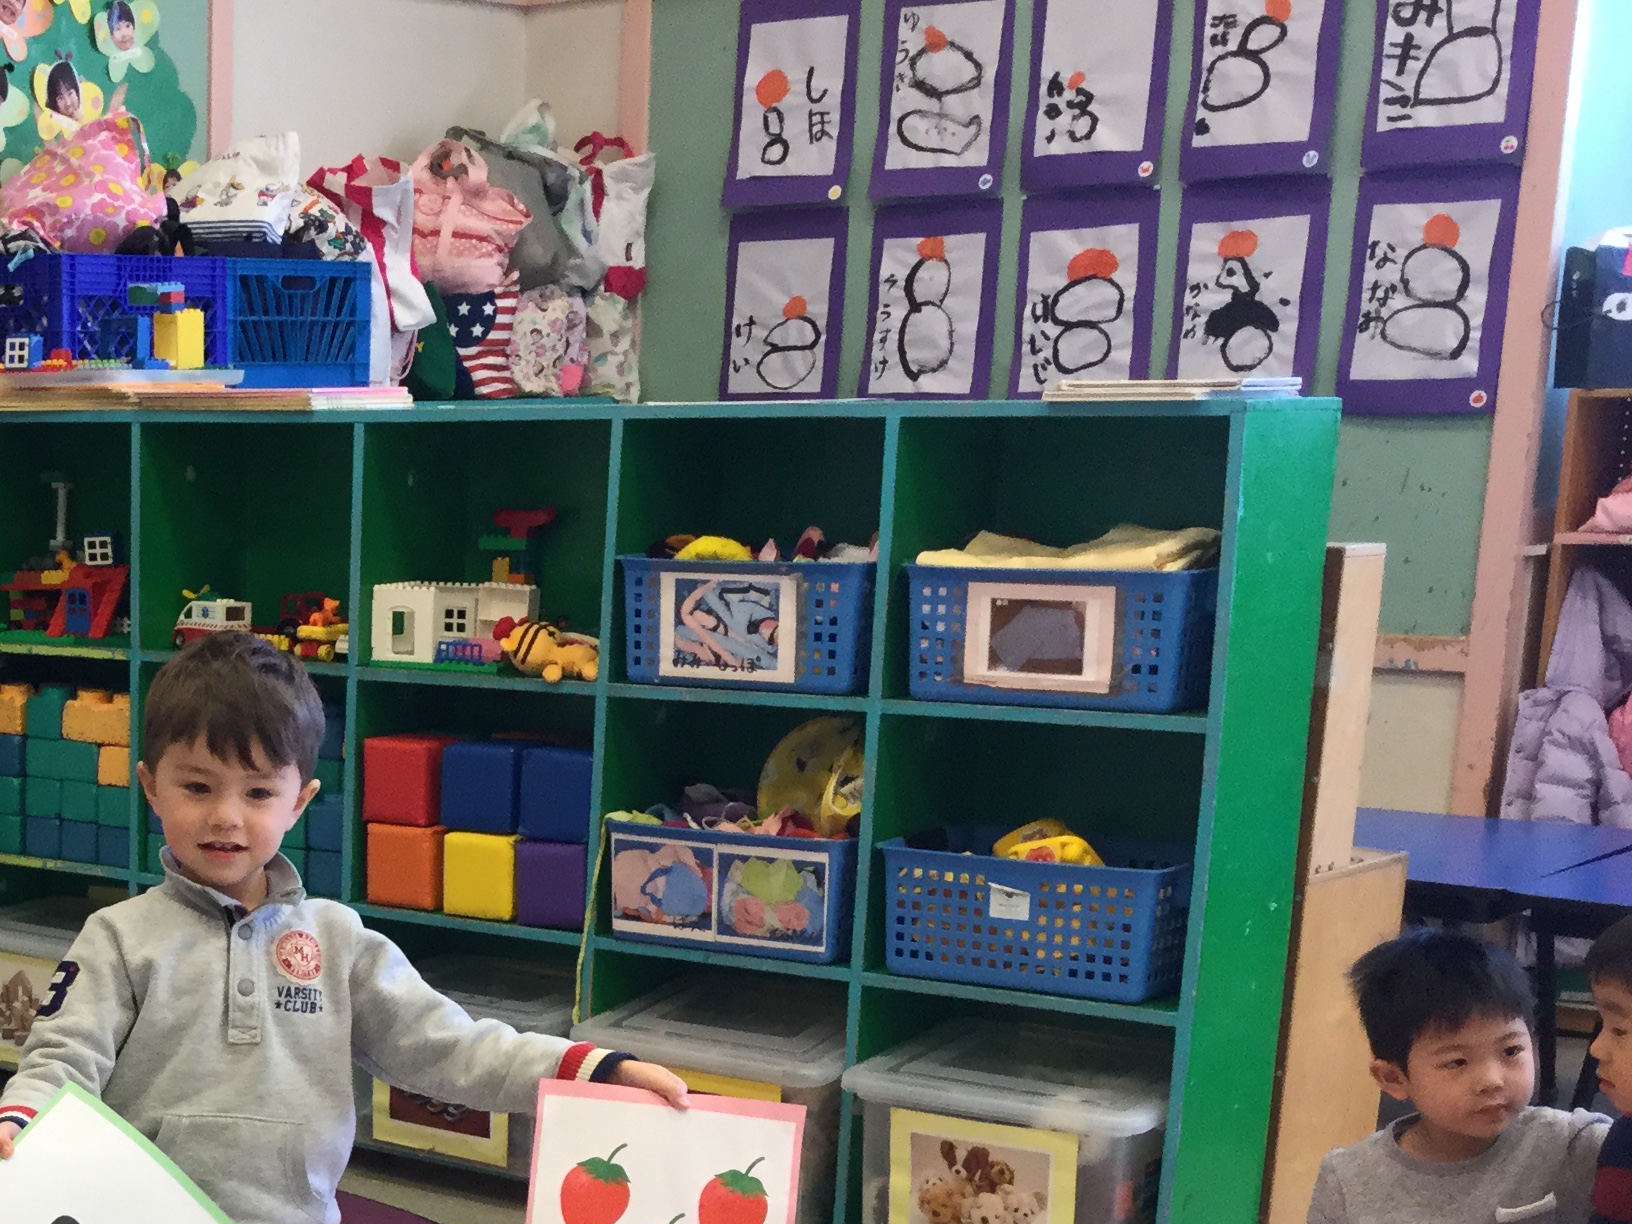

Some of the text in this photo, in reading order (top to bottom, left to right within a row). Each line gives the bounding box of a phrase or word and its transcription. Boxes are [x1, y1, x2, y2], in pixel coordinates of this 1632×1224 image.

[806, 66, 834, 145] しほ
[732, 314, 757, 374] けい
[284, 999, 318, 1014] CLUB
